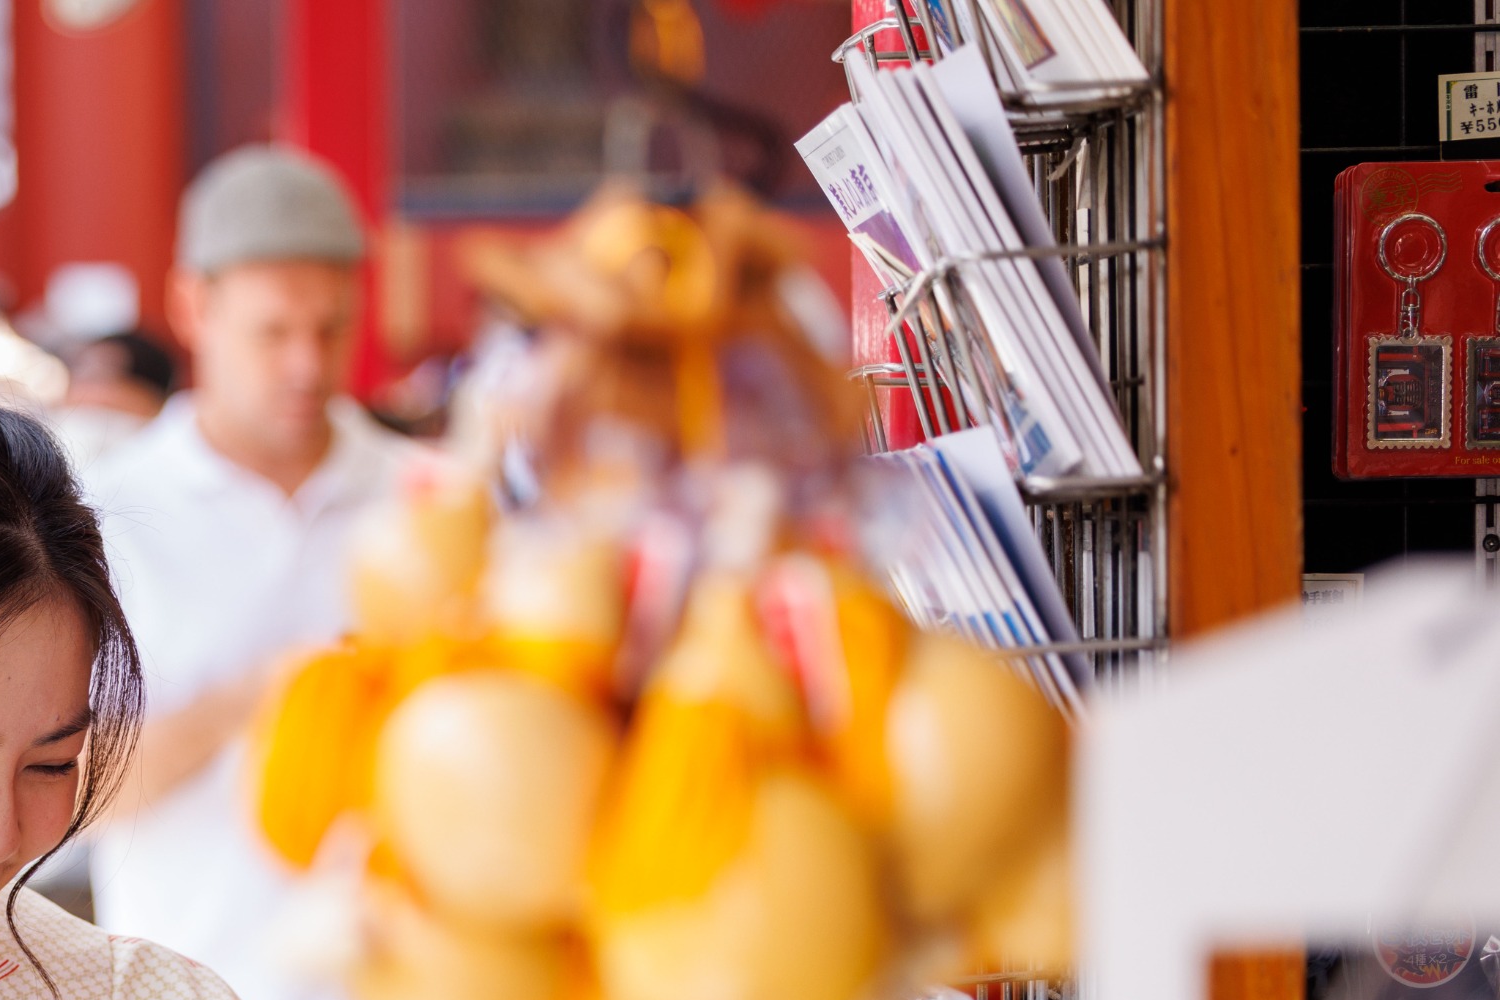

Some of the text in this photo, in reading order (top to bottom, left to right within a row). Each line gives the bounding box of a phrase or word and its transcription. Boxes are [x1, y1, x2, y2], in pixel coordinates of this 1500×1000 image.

[1469, 101, 1500, 117] キーホ
[1461, 117, 1500, 134] ¥55
[1455, 456, 1470, 465] For
[1472, 455, 1490, 465] sale
